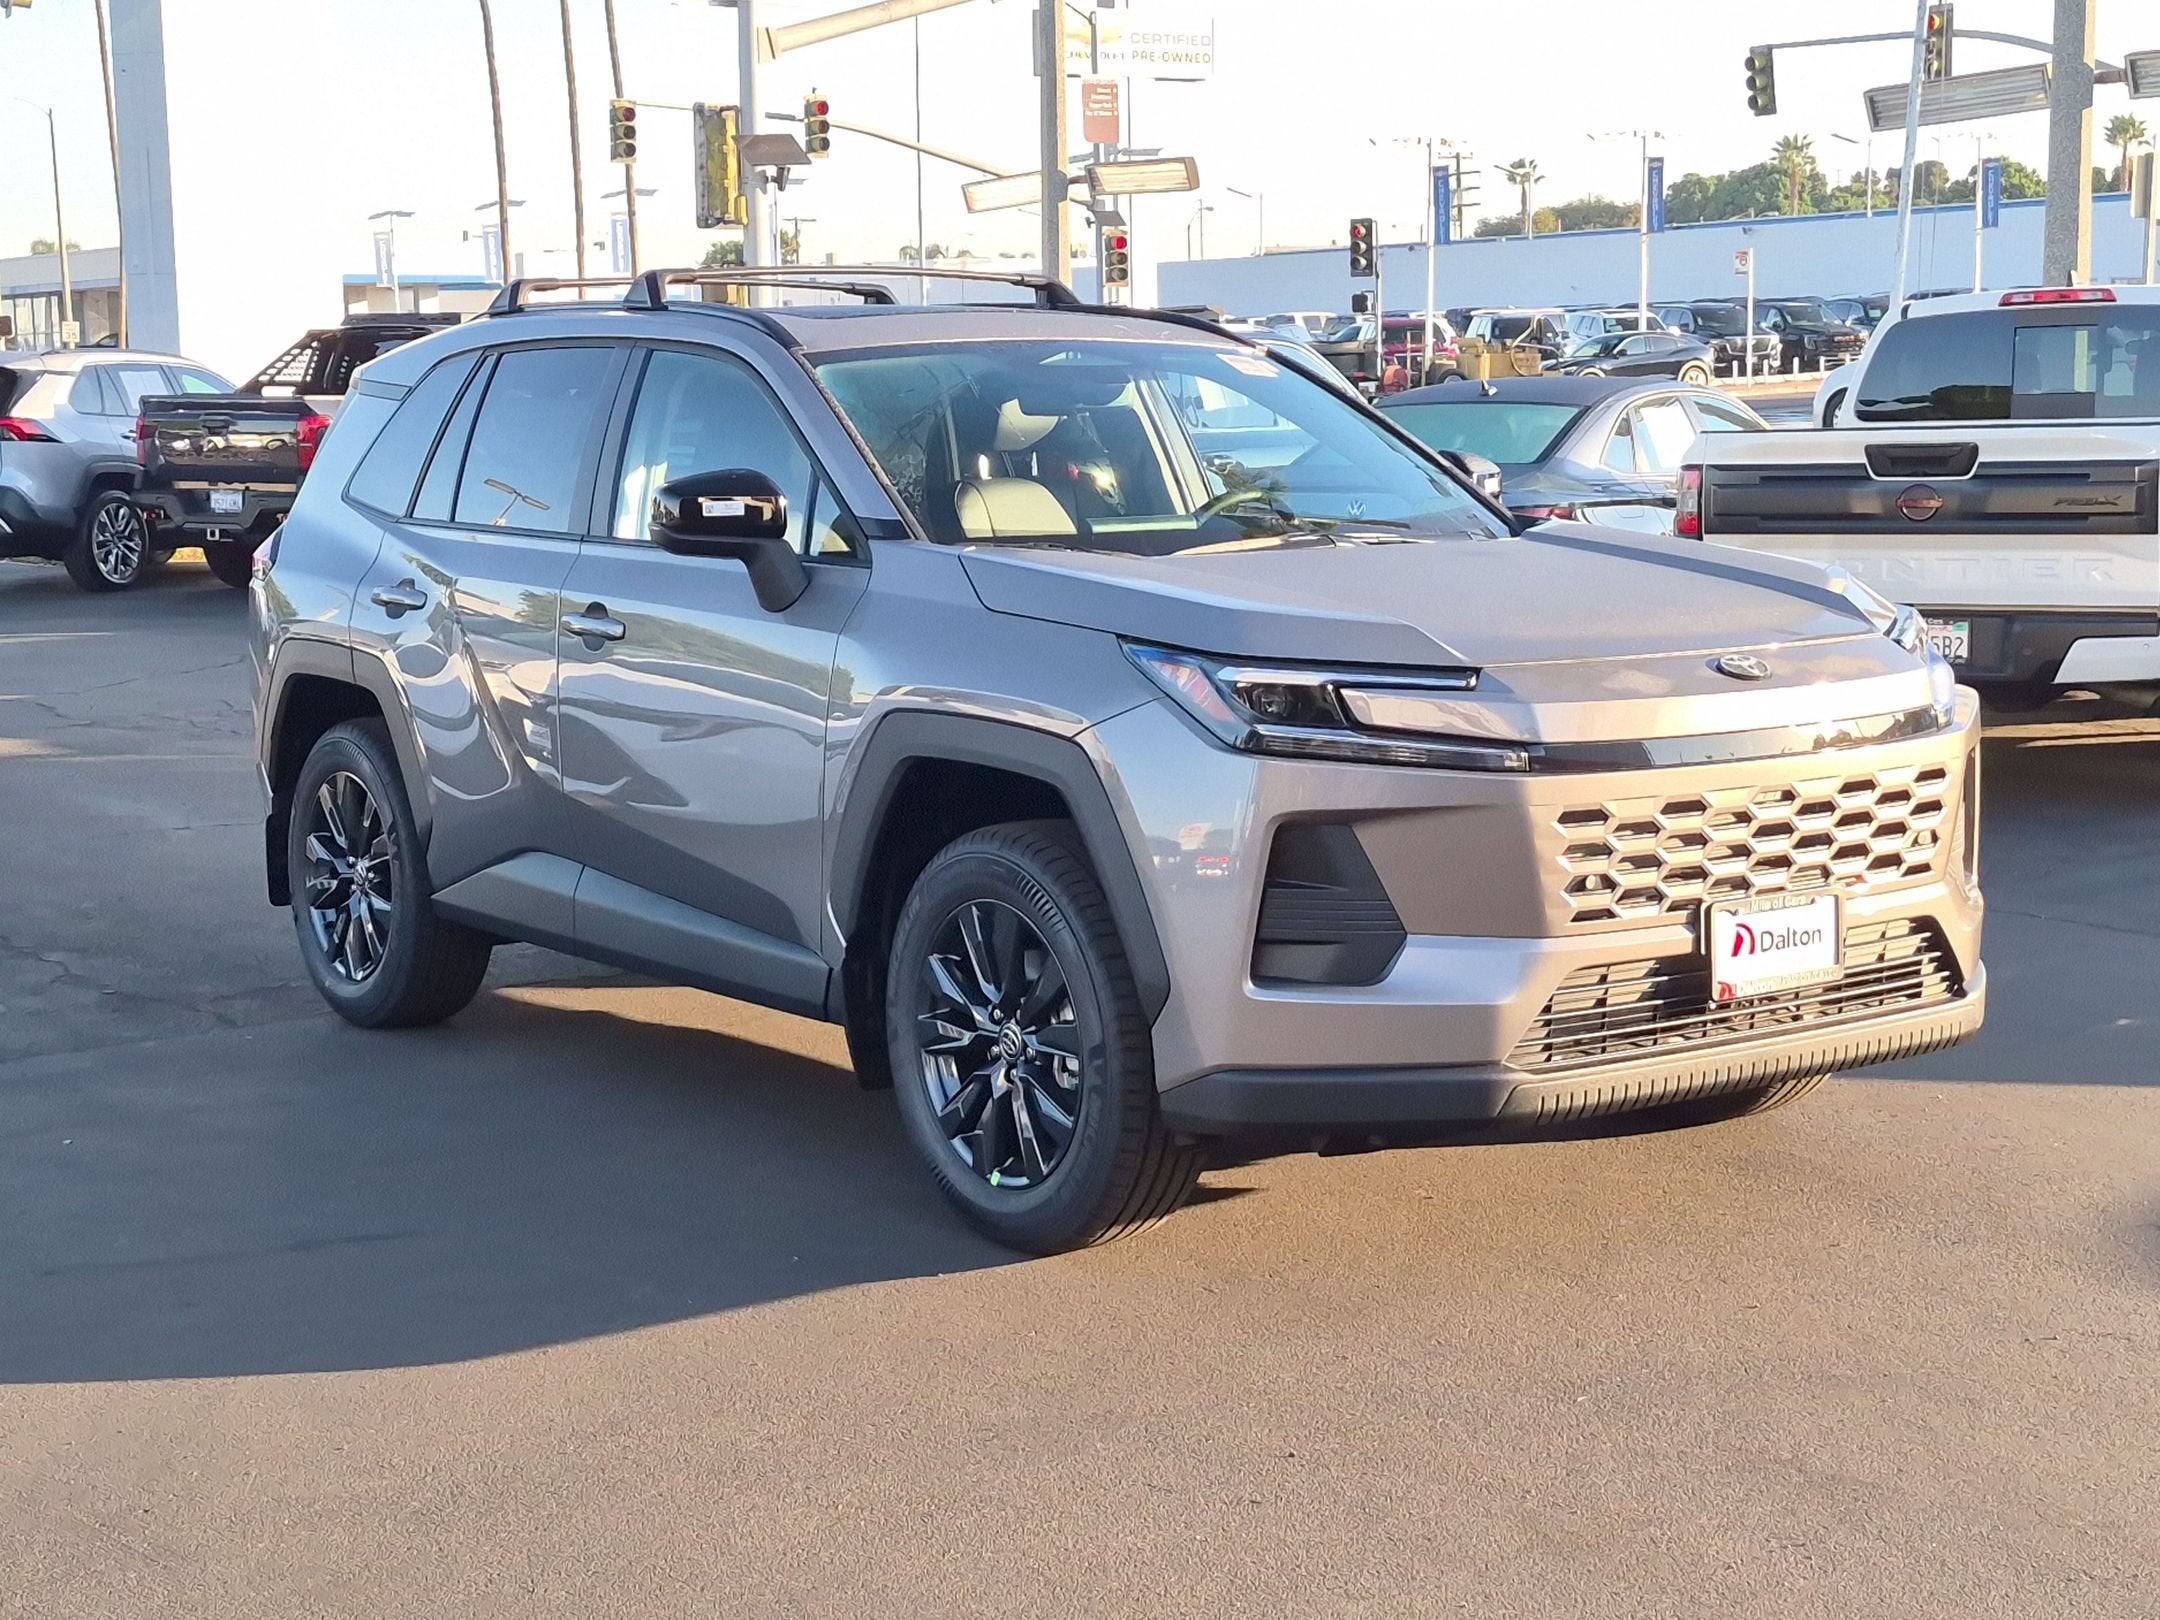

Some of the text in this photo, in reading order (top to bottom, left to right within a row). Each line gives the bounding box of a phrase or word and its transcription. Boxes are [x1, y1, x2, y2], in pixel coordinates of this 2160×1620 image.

[1130, 32, 1211, 46] CERTIFIED
[1131, 50, 1211, 64] PRE-OWNED
[1931, 636, 1964, 657] 5B2
[1760, 927, 1822, 952] Dalton
